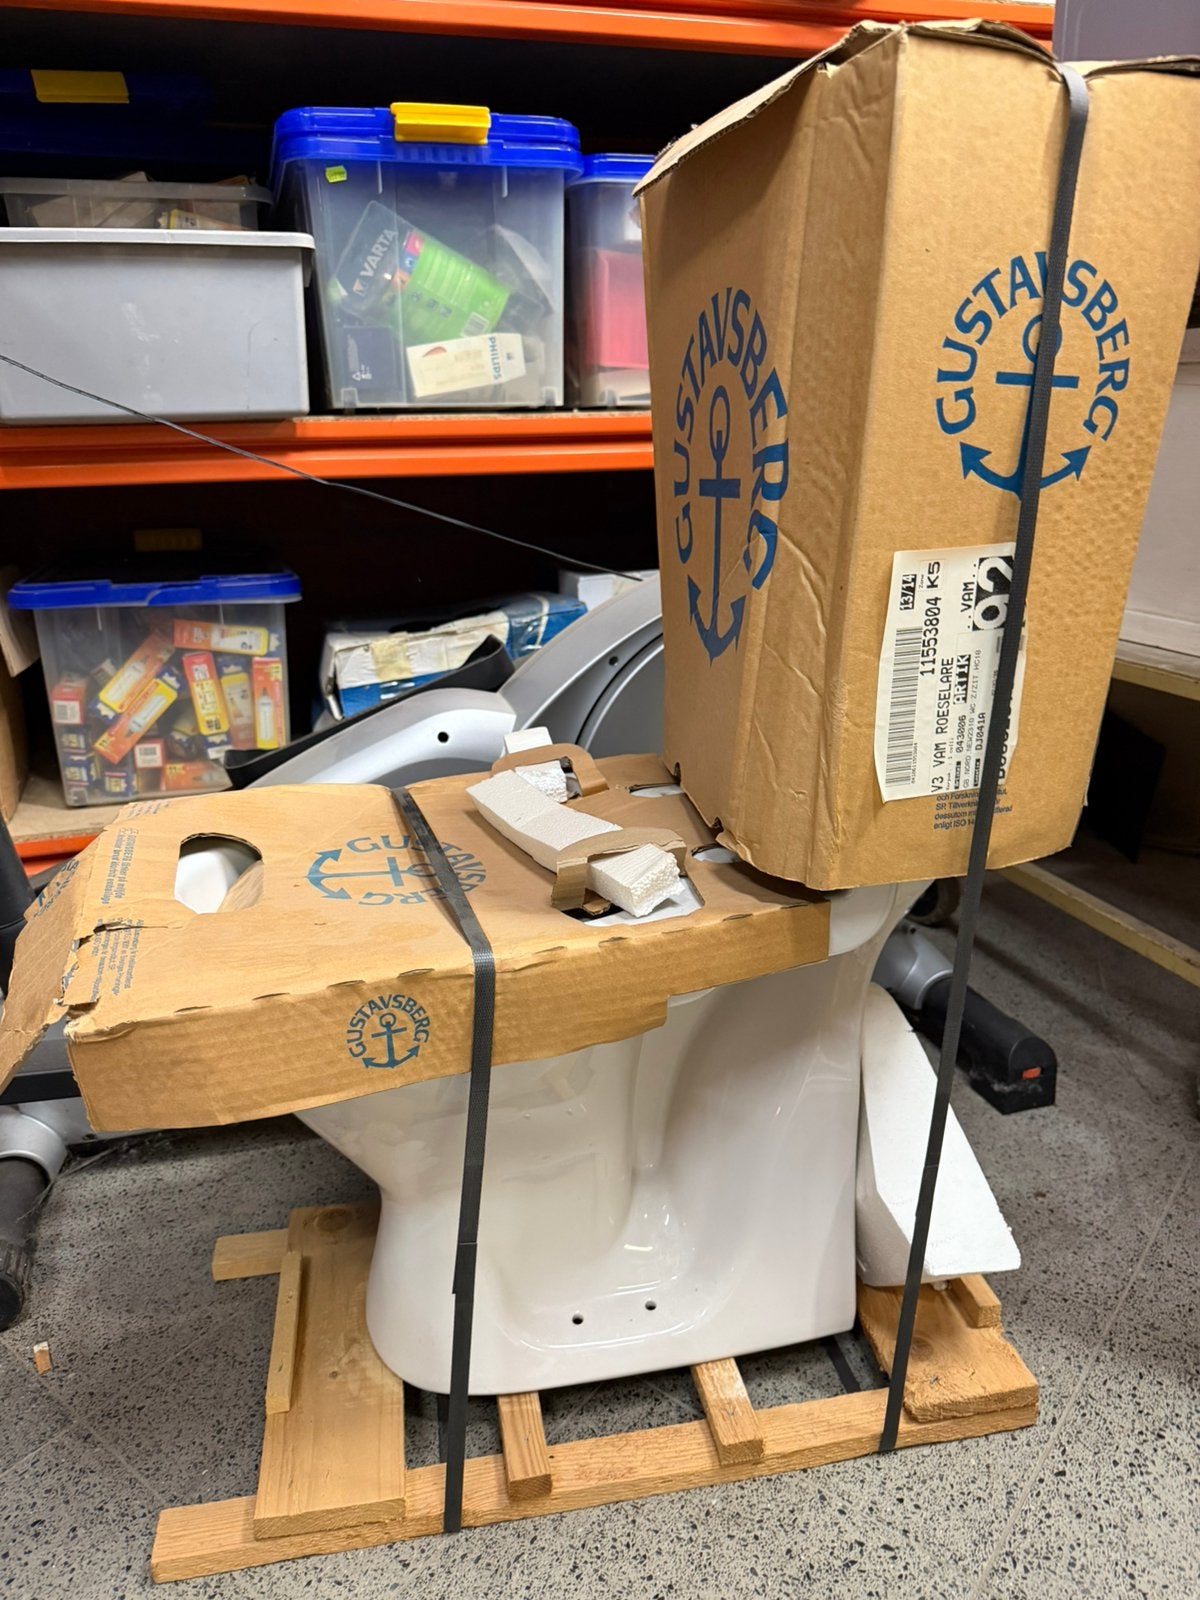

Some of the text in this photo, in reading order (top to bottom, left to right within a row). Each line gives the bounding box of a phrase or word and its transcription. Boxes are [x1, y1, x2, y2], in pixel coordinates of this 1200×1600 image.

[360, 228, 398, 279] VARTA
[488, 336, 503, 381] PHILIPS
[673, 286, 790, 590] GUSTAVSBERG
[900, 574, 917, 610] 13/14
[920, 561, 941, 676] 11553804 K5
[954, 653, 971, 705] ARTIK
[930, 656, 955, 793] V3 VAM ROESELARE
[956, 714, 967, 754] 043006
[975, 712, 986, 750] DJ041A
[954, 819, 966, 828] ISO
[346, 993, 431, 1058] GUSTAVSBERG
